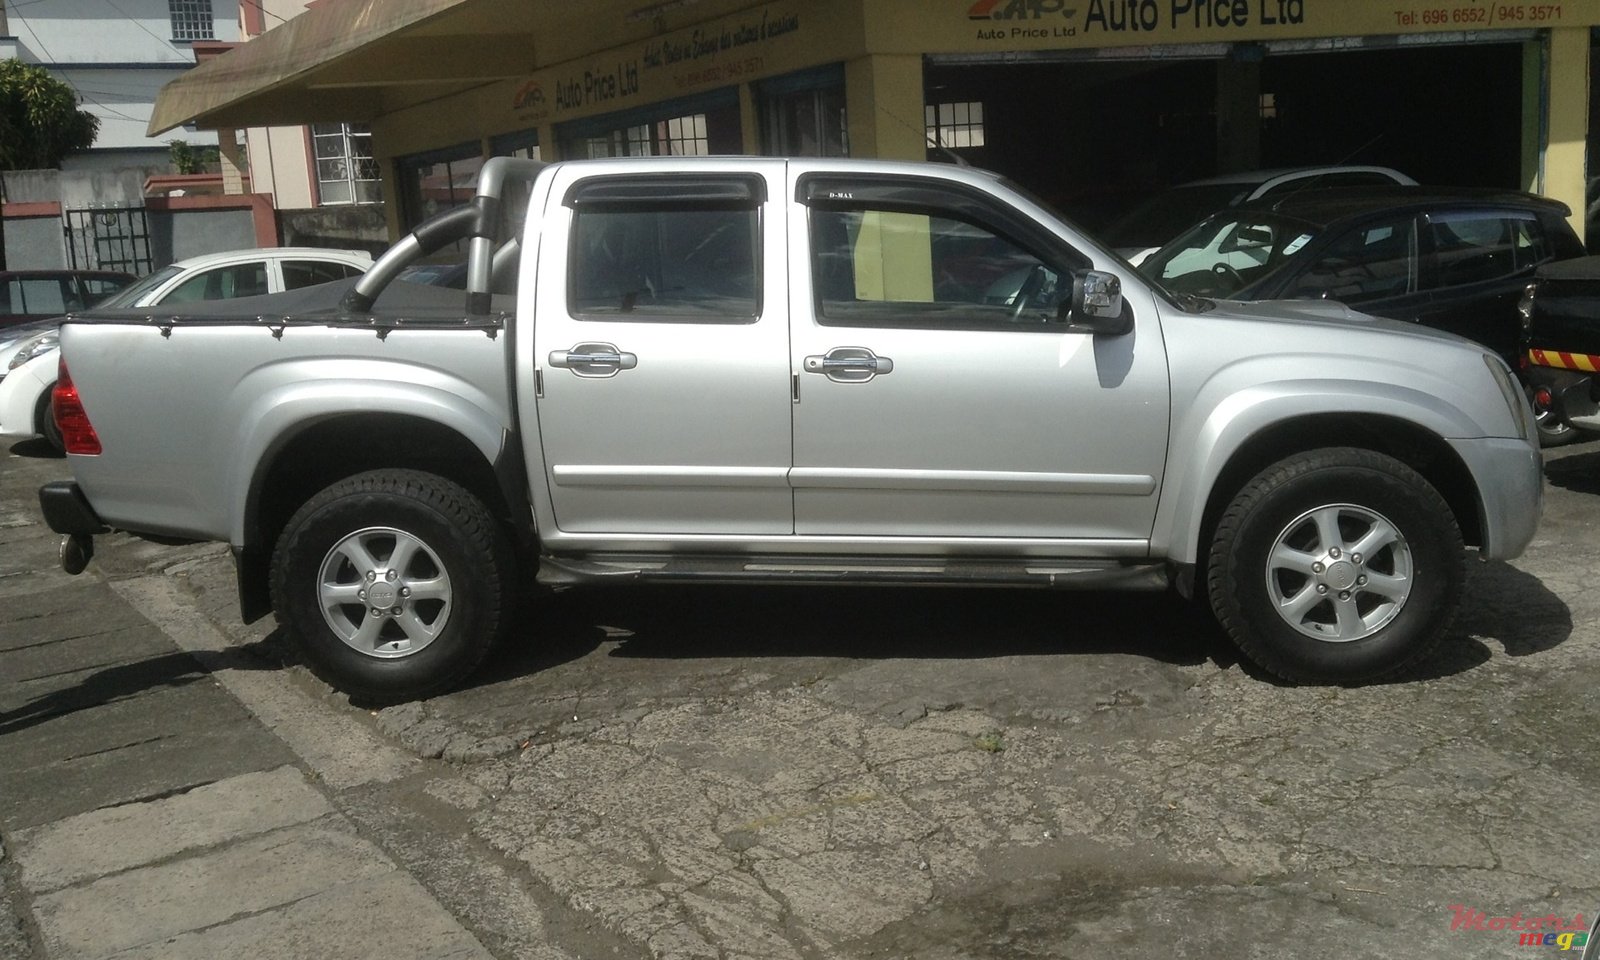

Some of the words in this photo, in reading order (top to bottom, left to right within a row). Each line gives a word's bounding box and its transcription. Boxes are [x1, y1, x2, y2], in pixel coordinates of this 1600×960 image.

[1084, 0, 1158, 32] Auto
[1172, 0, 1248, 29] Price
[1260, 0, 1304, 25] Ltd
[1394, 10, 1418, 26] Tel:
[1422, 9, 1448, 24] 696
[1452, 8, 1485, 23] 6552
[1498, 6, 1525, 21] 945
[1529, 5, 1562, 21] 3571
[977, 29, 1006, 40] Auto
[1011, 27, 1048, 39] Price
[1054, 27, 1076, 37] Ltd
[555, 79, 582, 112] Auto
[584, 70, 616, 105] Price
[618, 60, 639, 97] Ltd
